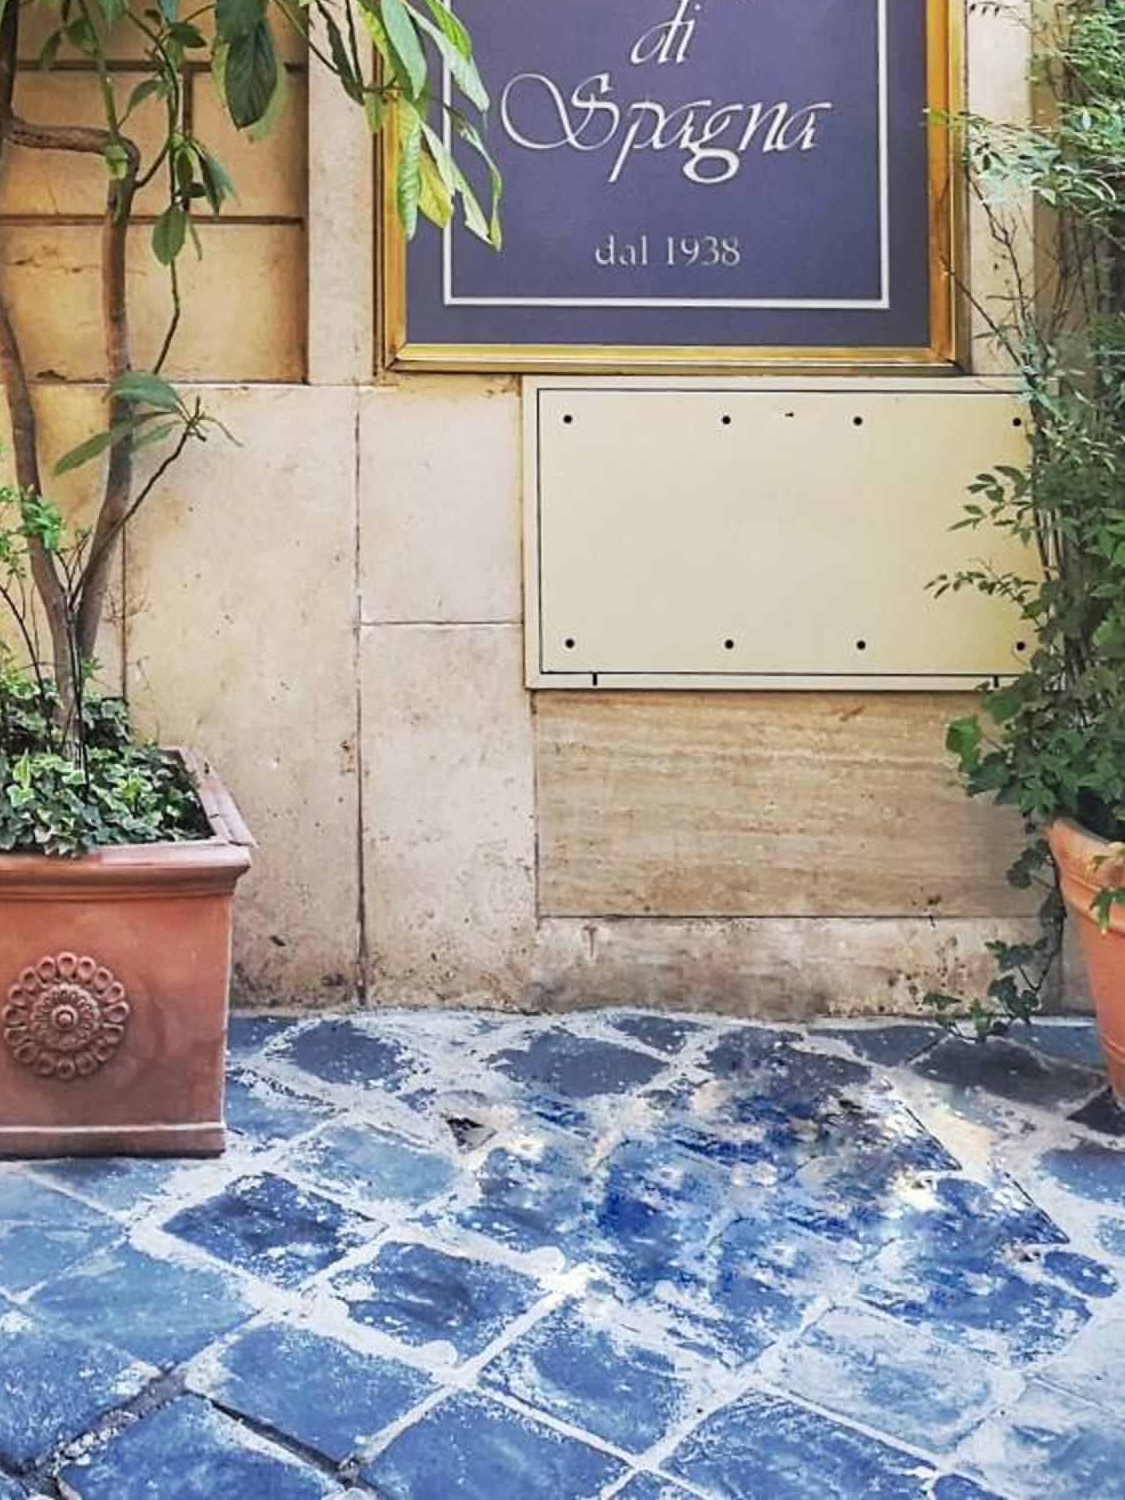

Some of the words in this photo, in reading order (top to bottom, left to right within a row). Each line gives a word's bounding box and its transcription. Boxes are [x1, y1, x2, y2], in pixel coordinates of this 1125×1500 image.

[501, 72, 832, 184] Spagna
[595, 235, 647, 265] dal
[668, 236, 740, 266] 1938
